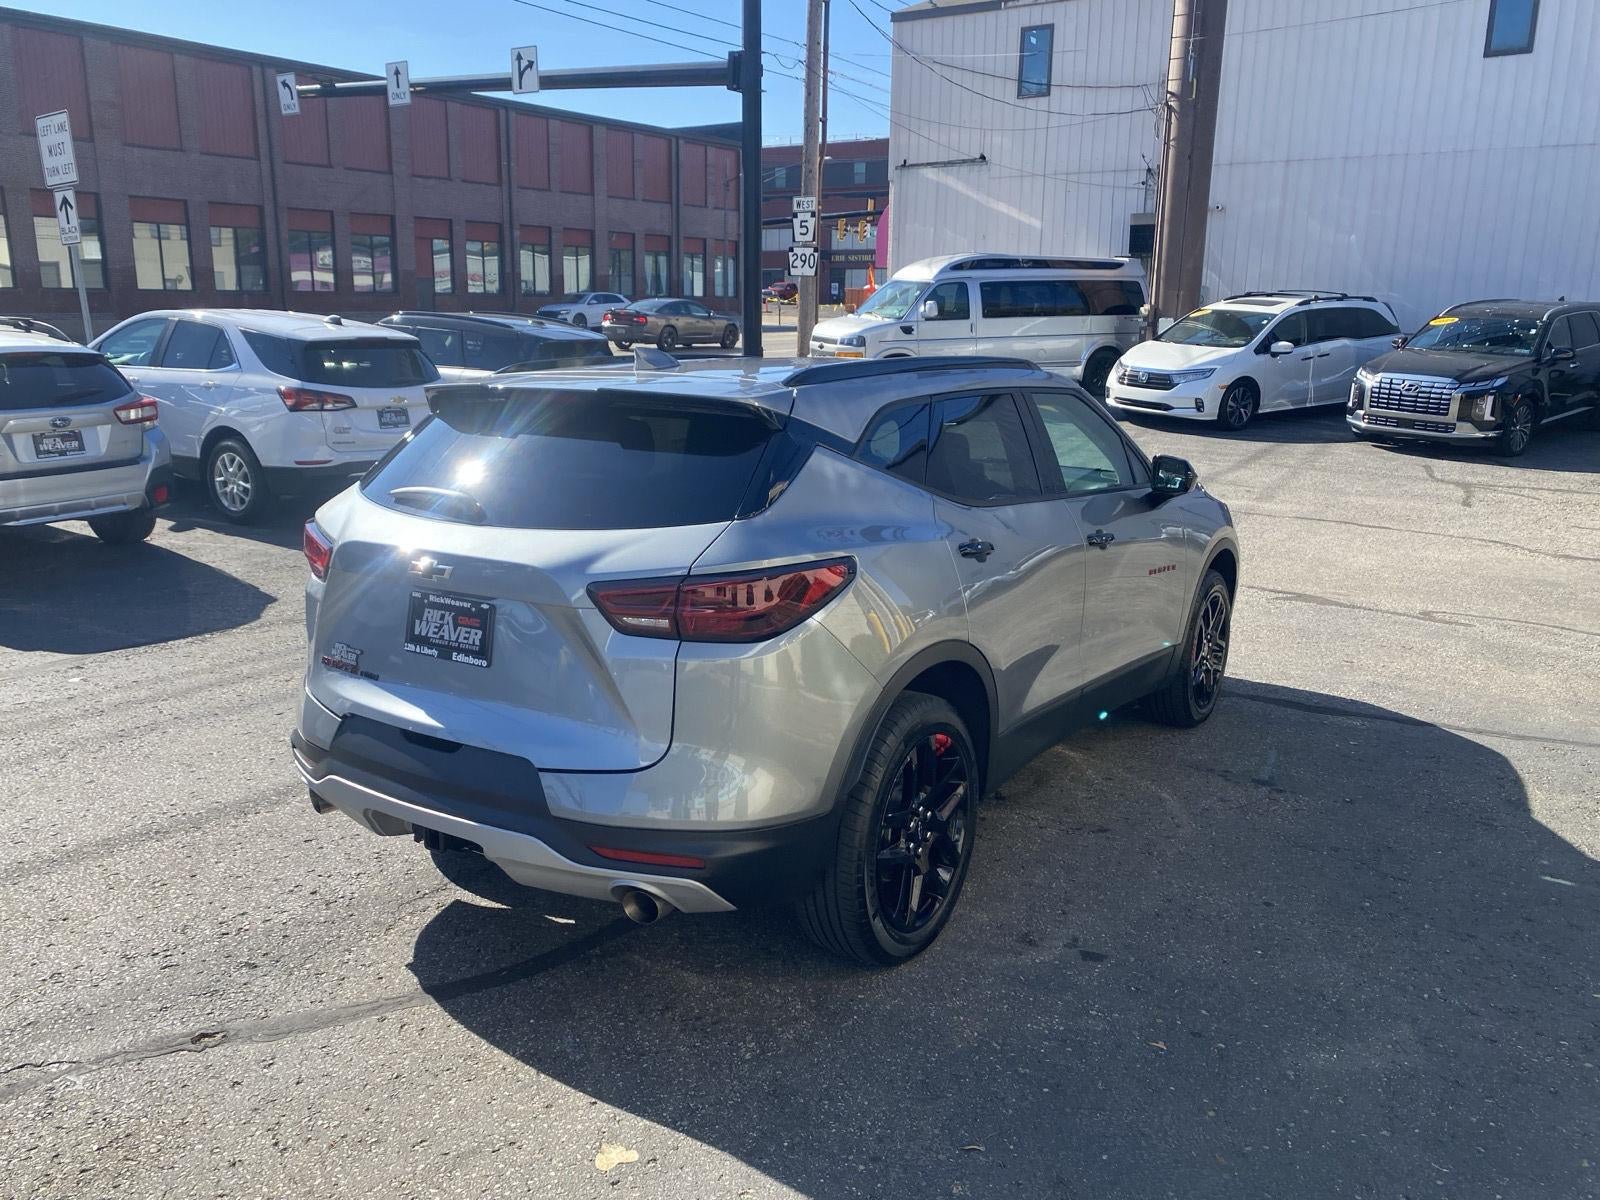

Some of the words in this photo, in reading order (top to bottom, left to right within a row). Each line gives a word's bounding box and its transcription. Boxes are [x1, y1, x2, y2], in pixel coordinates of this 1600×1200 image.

[391, 92, 407, 101] ONLY
[282, 103, 297, 112] ONLY
[40, 125, 52, 137] LEFT
[53, 120, 68, 133] LANE
[47, 141, 66, 158] MUST
[46, 165, 61, 178] TURN
[61, 162, 74, 175] LEFT
[796, 199, 814, 209] WEST
[61, 226, 78, 236] BLACK
[799, 219, 809, 236] 5
[791, 252, 816, 269] 290
[39, 440, 79, 451] WEAVER
[429, 594, 472, 608] RickWeaver
[422, 607, 456, 625] RICK
[458, 615, 481, 627] GMC
[414, 619, 483, 646] WEAVER
[403, 642, 416, 652] 12th
[420, 645, 439, 658] Liberty
[451, 651, 488, 668] Edinboro
